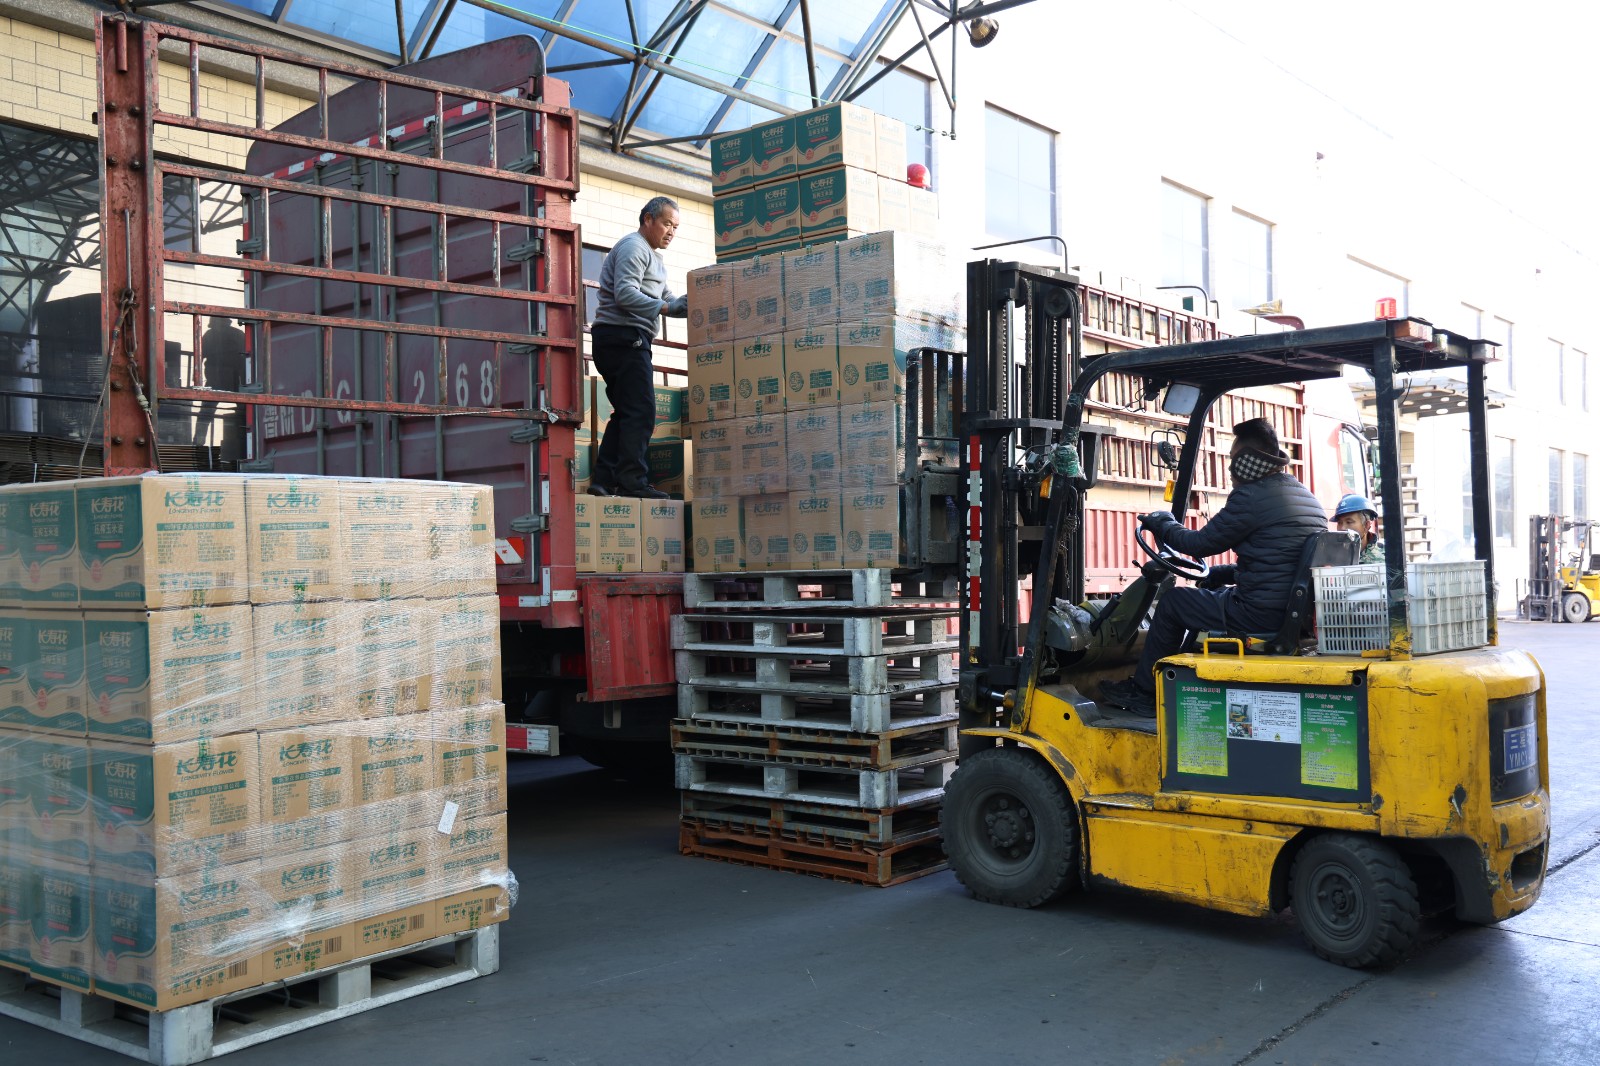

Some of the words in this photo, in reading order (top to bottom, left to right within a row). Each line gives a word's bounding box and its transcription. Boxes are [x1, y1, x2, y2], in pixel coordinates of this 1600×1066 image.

[91, 497, 124, 513] 长寿花
[165, 490, 225, 507] 长寿花
[267, 493, 321, 508] 长寿花
[29, 501, 60, 518] 长寿花
[604, 505, 631, 514] 长寿花
[651, 506, 676, 516] 长寿花
[38, 629, 68, 645] 长寿花
[99, 631, 131, 648] 长寿花
[172, 622, 232, 642] 长寿花
[279, 739, 334, 761] 长寿花
[104, 760, 137, 779] 长寿花
[177, 751, 238, 775] 长寿花
